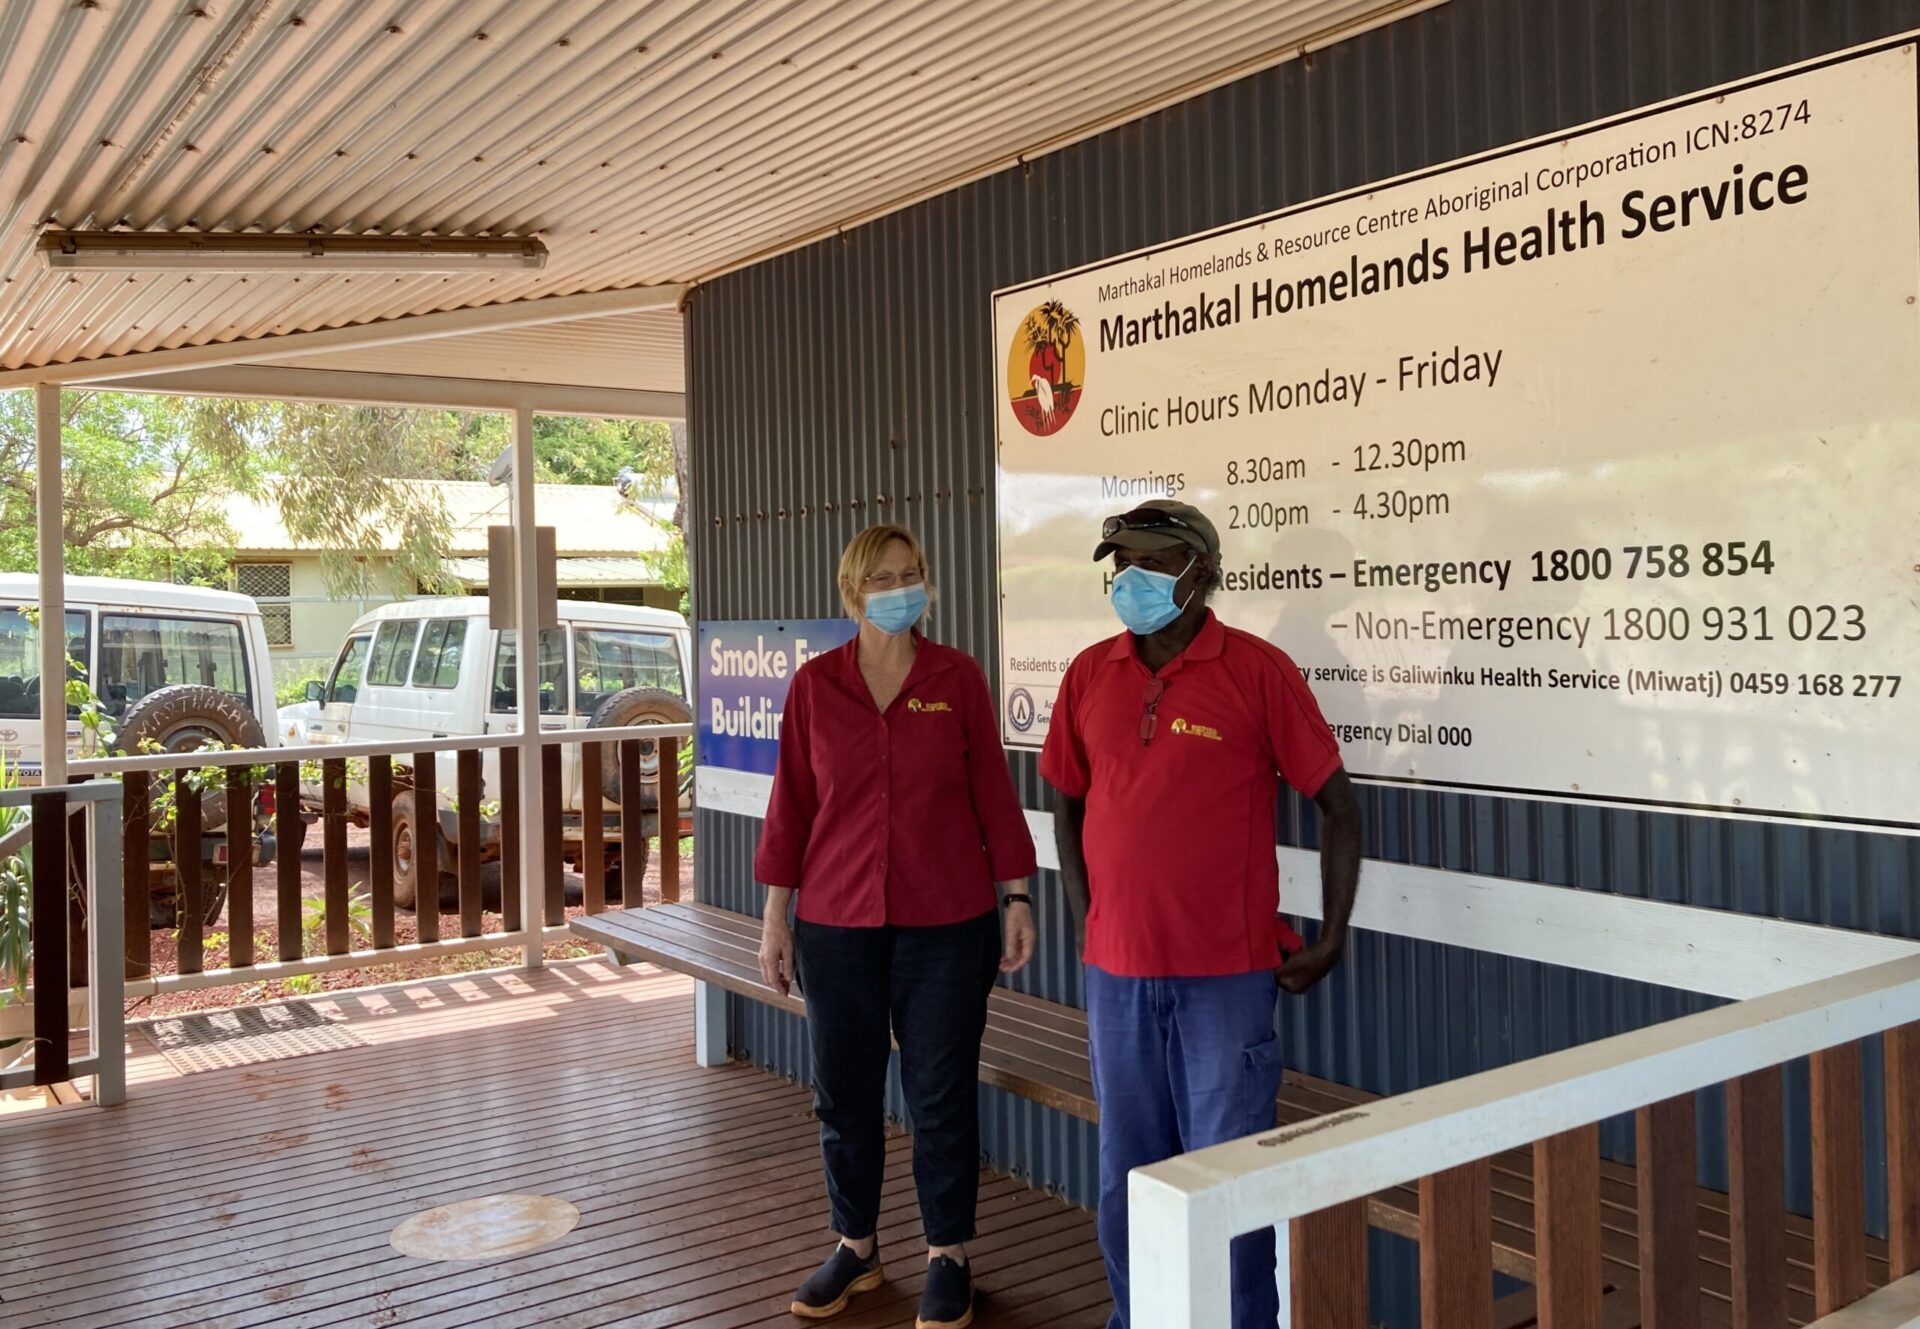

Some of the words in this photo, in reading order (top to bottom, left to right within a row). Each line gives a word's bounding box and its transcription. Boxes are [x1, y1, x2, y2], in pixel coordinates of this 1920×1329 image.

[1098, 268, 1165, 302] Marthakal
[1169, 247, 1252, 284] Homelands
[1256, 242, 1269, 262] &
[1274, 222, 1350, 257] Resource
[1356, 206, 1419, 236] Centre
[1424, 173, 1529, 219] Aboriginal
[1535, 137, 1677, 192] Corporation
[1685, 99, 1812, 154] ICN:8274
[1100, 284, 1241, 352] Marthakal
[1251, 238, 1450, 319] Homelands
[1463, 199, 1604, 273] Health
[1621, 162, 1809, 239] Service
[1100, 402, 1159, 436] Clinic
[1166, 392, 1239, 427] Hours
[1248, 367, 1367, 415] Monday
[1398, 345, 1503, 391] Friday
[1101, 471, 1185, 499] Mornings
[1226, 457, 1306, 486] 8.30am
[1353, 438, 1466, 473] 12.30pm
[1228, 502, 1309, 533] 2.00pm
[1352, 490, 1450, 526] 4.30pm
[1354, 558, 1512, 593] Emergency
[1531, 547, 1612, 583] 1800
[1622, 543, 1690, 580] 758
[1701, 540, 1775, 577] 854
[1355, 608, 1591, 648] Non-Emergency
[1603, 607, 1690, 642] 1800
[1701, 605, 1774, 642] 931
[1787, 604, 1867, 642] 023
[711, 635, 788, 679] Smoke
[1010, 657, 1057, 672] Residents
[1314, 664, 1368, 682] service
[1372, 664, 1385, 683] is
[1389, 665, 1475, 685] Galiwinku
[1479, 667, 1542, 689] Health
[1548, 669, 1621, 691] Service
[1627, 669, 1724, 699] (Miwatj)
[1729, 672, 1789, 695] 0459
[1797, 674, 1844, 697] 168
[1852, 675, 1901, 698] 277
[1329, 723, 1393, 746] ergency
[1397, 723, 1432, 745] Dial
[1438, 726, 1472, 747] 000
